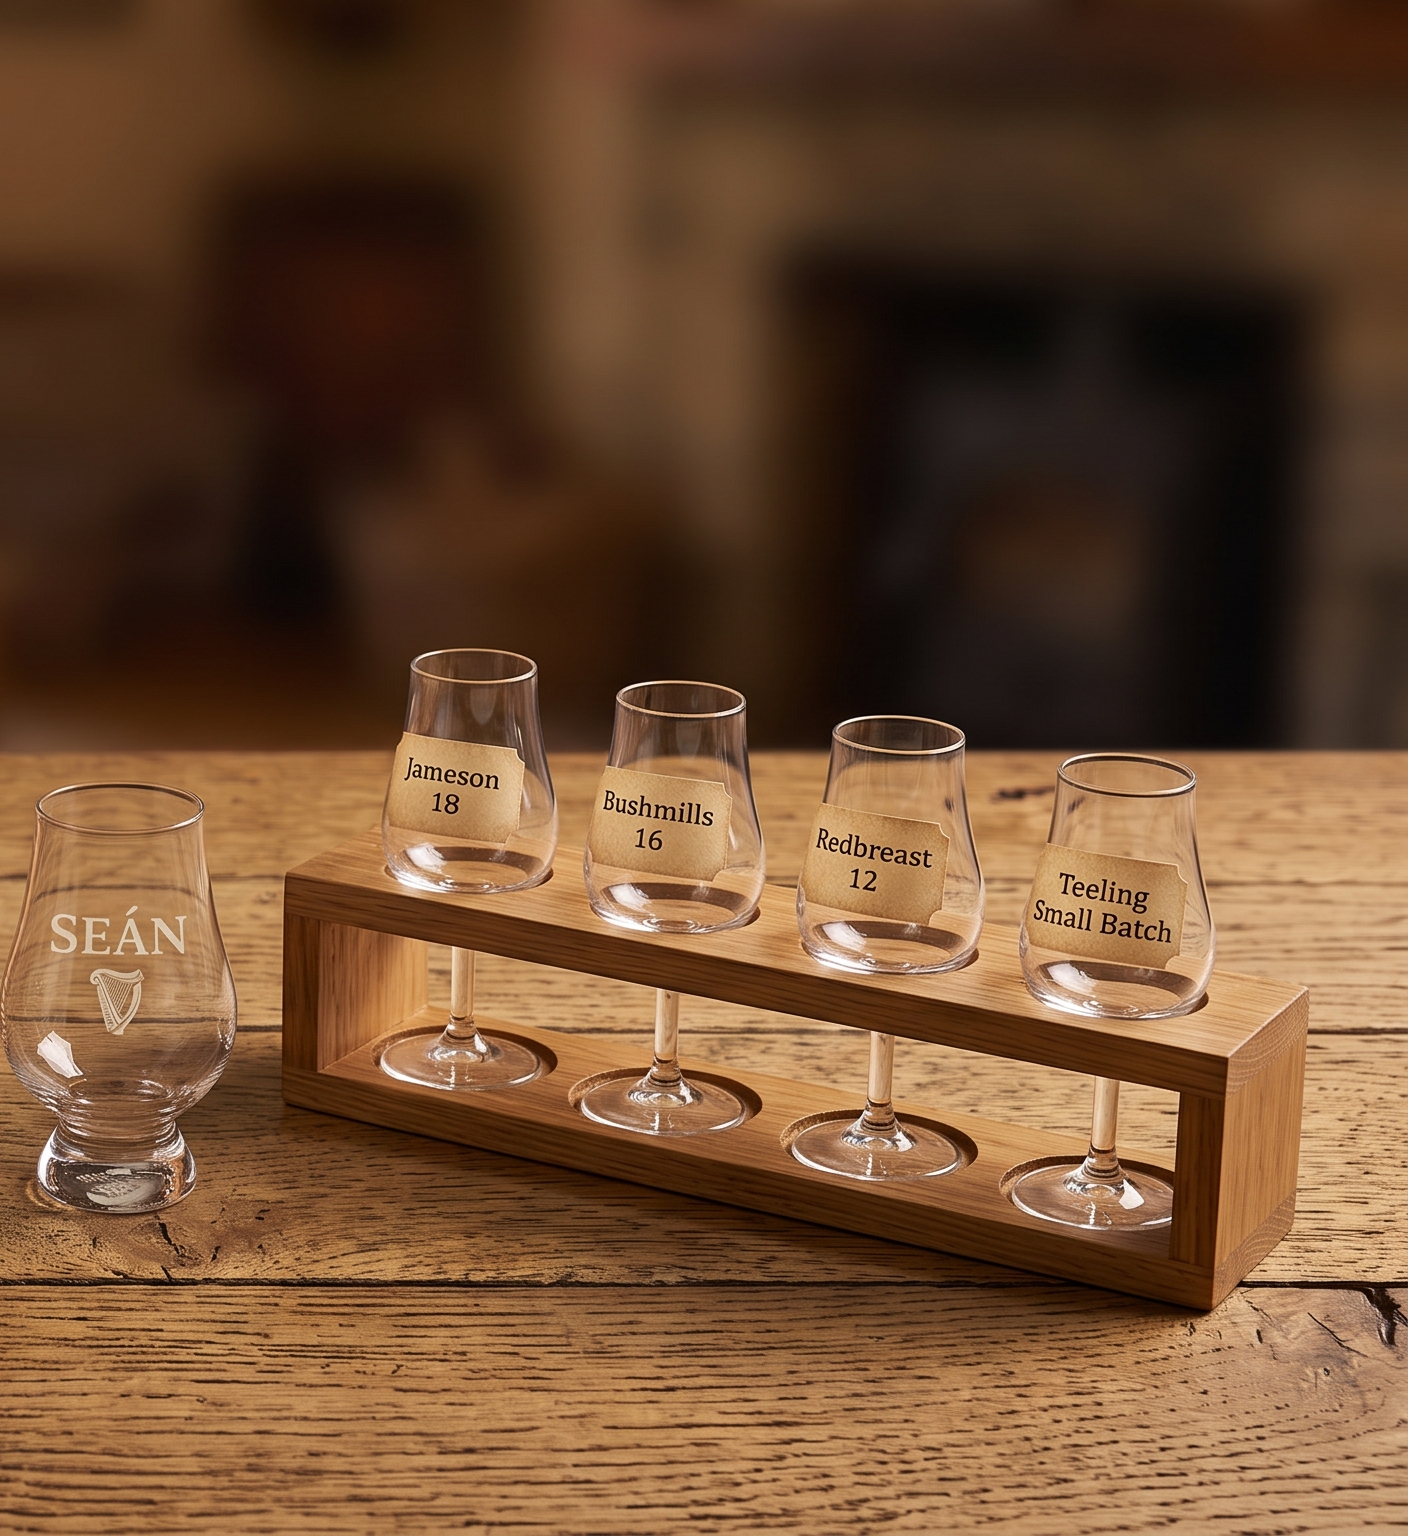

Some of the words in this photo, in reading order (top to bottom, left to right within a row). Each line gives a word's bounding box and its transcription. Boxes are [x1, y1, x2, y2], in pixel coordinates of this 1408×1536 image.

[404, 757, 500, 790] Jameson
[431, 792, 460, 815] 18
[602, 790, 714, 827] Bushmills
[634, 828, 663, 851] 16
[815, 827, 933, 869] Redbreast
[848, 868, 878, 892] 12
[1058, 872, 1150, 914] Teeling
[50, 905, 188, 956] SEÁN
[1033, 899, 1093, 933] Small
[1098, 912, 1173, 944] Batch
